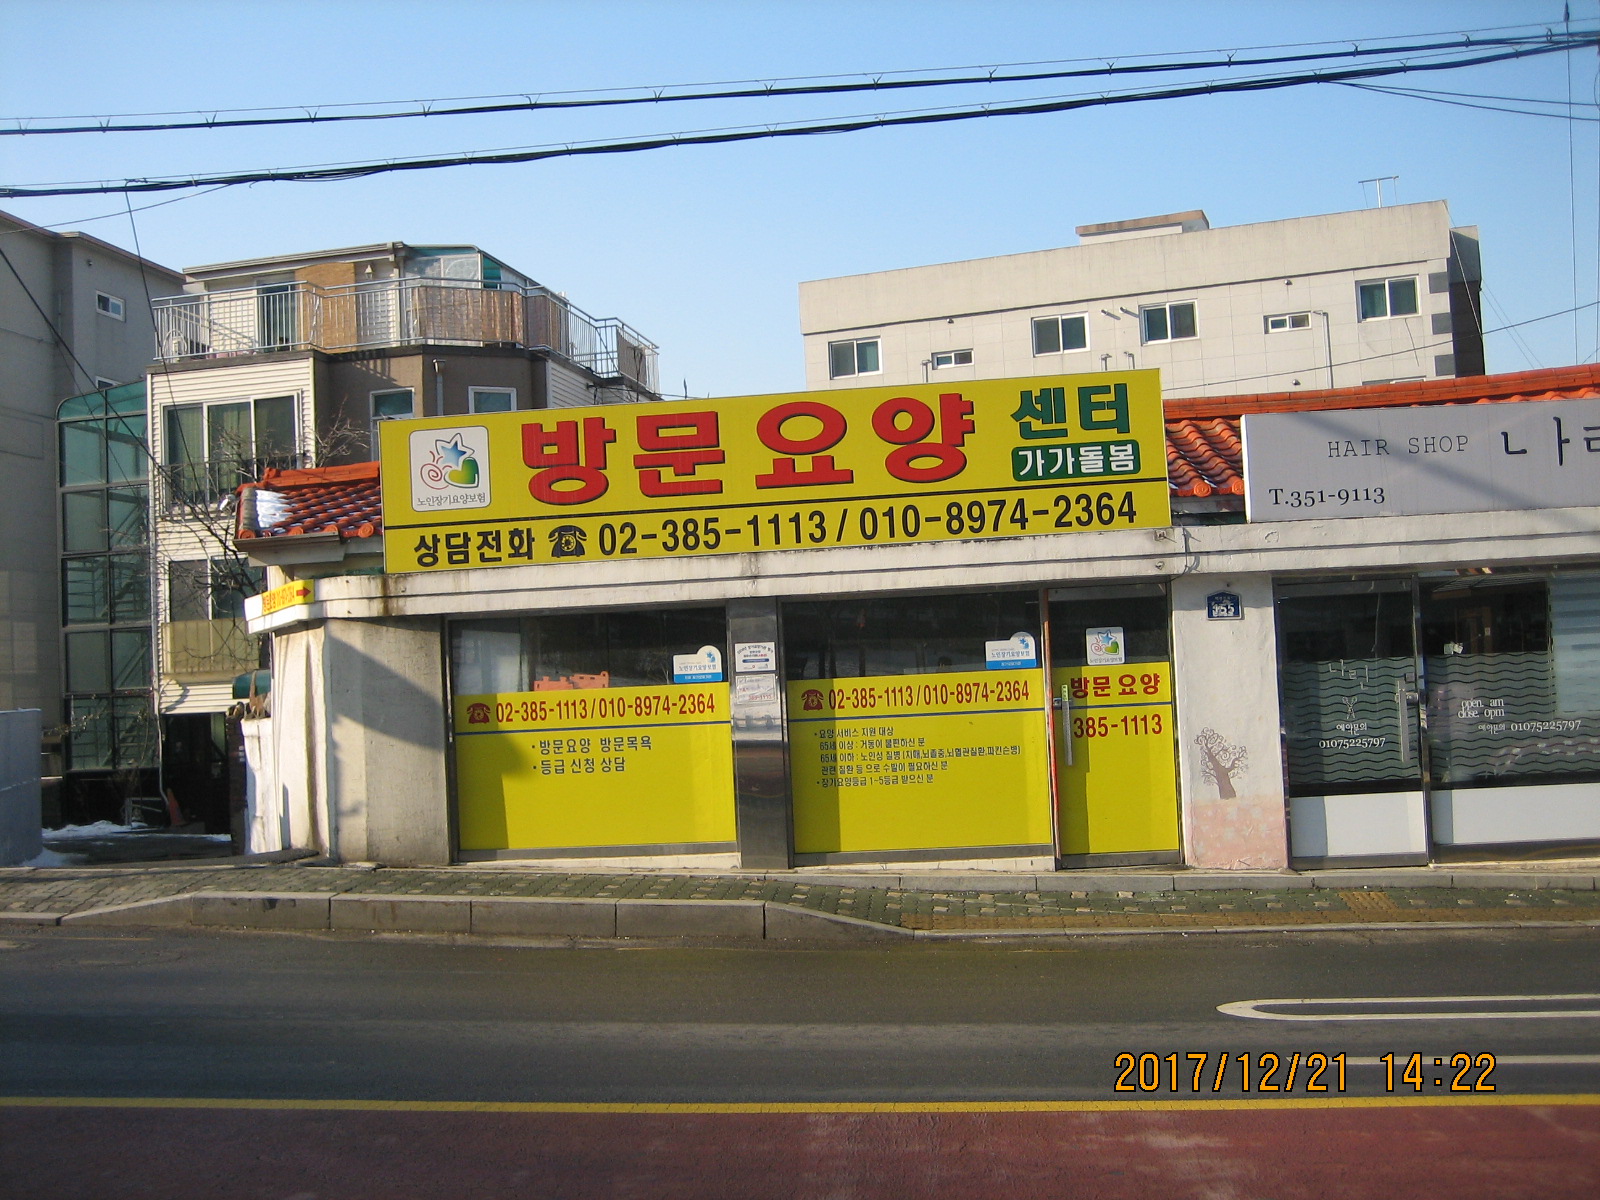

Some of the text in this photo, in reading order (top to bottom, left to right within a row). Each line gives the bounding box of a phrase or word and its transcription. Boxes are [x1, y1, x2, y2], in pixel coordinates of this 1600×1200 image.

[521, 383, 1131, 506] 방문요양 센터
[1327, 435, 1469, 458] HAIR SHOP
[1018, 443, 1135, 477] 가가돌봄
[417, 492, 486, 506] 노인장기요양보험
[1269, 487, 1385, 508] T.351-9113
[413, 527, 535, 567] 상담전화
[828, 681, 1030, 711] 02-385-1113/010-8974-2364
[495, 692, 716, 723] 02-385-1113/010-8974-2364
[819, 726, 895, 739] 요양 서비스 지원 대상
[1073, 713, 1163, 738] 385-1113
[1336, 722, 1368, 736] 예약문의
[1510, 719, 1582, 733] 01075225797
[539, 735, 652, 756] 방문요양 방문목욕
[860, 739, 883, 749] 거동이
[885, 737, 915, 749] 불편하신
[1318, 737, 1386, 750] 01075225797
[540, 756, 625, 775] 등급 신청 상담
[860, 752, 884, 762] 노인성
[821, 766, 836, 776] 관련
[838, 765, 854, 775] 질환
[883, 762, 906, 774] 수발이
[907, 761, 939, 772] 필요하신
[821, 777, 867, 788] 장기요양등급
[869, 775, 899, 786] 1~5등급
[901, 774, 924, 784] 받으신
